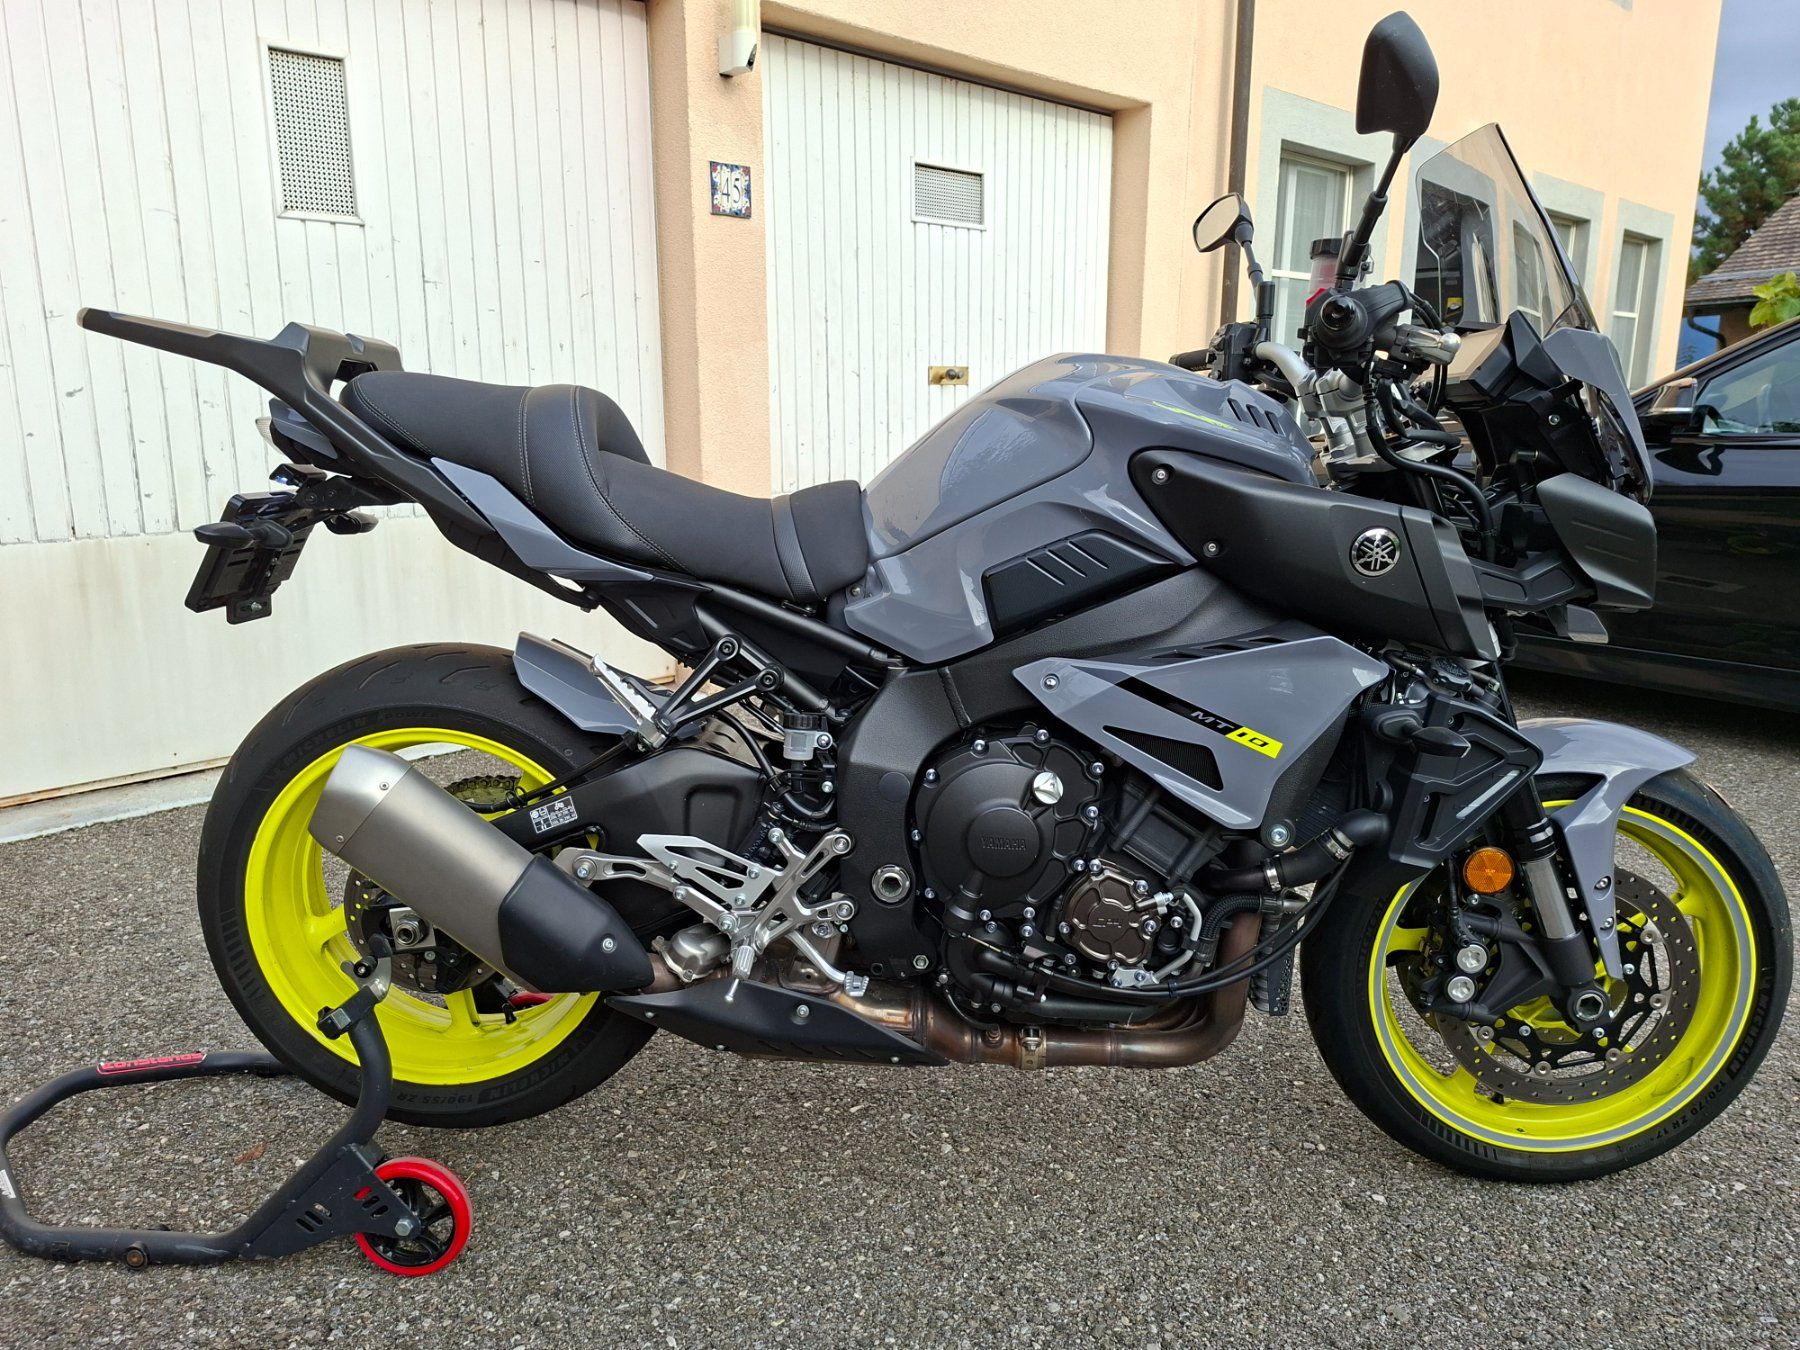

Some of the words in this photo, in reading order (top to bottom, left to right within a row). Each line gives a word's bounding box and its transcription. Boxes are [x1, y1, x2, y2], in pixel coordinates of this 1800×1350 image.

[721, 177, 741, 203] 45
[1191, 711, 1235, 729] MT
[1236, 732, 1269, 748] 10
[981, 836, 1027, 851] YAMAHA
[1728, 993, 1769, 1073] MICHELIN
[487, 1051, 571, 1100] MICHELIN
